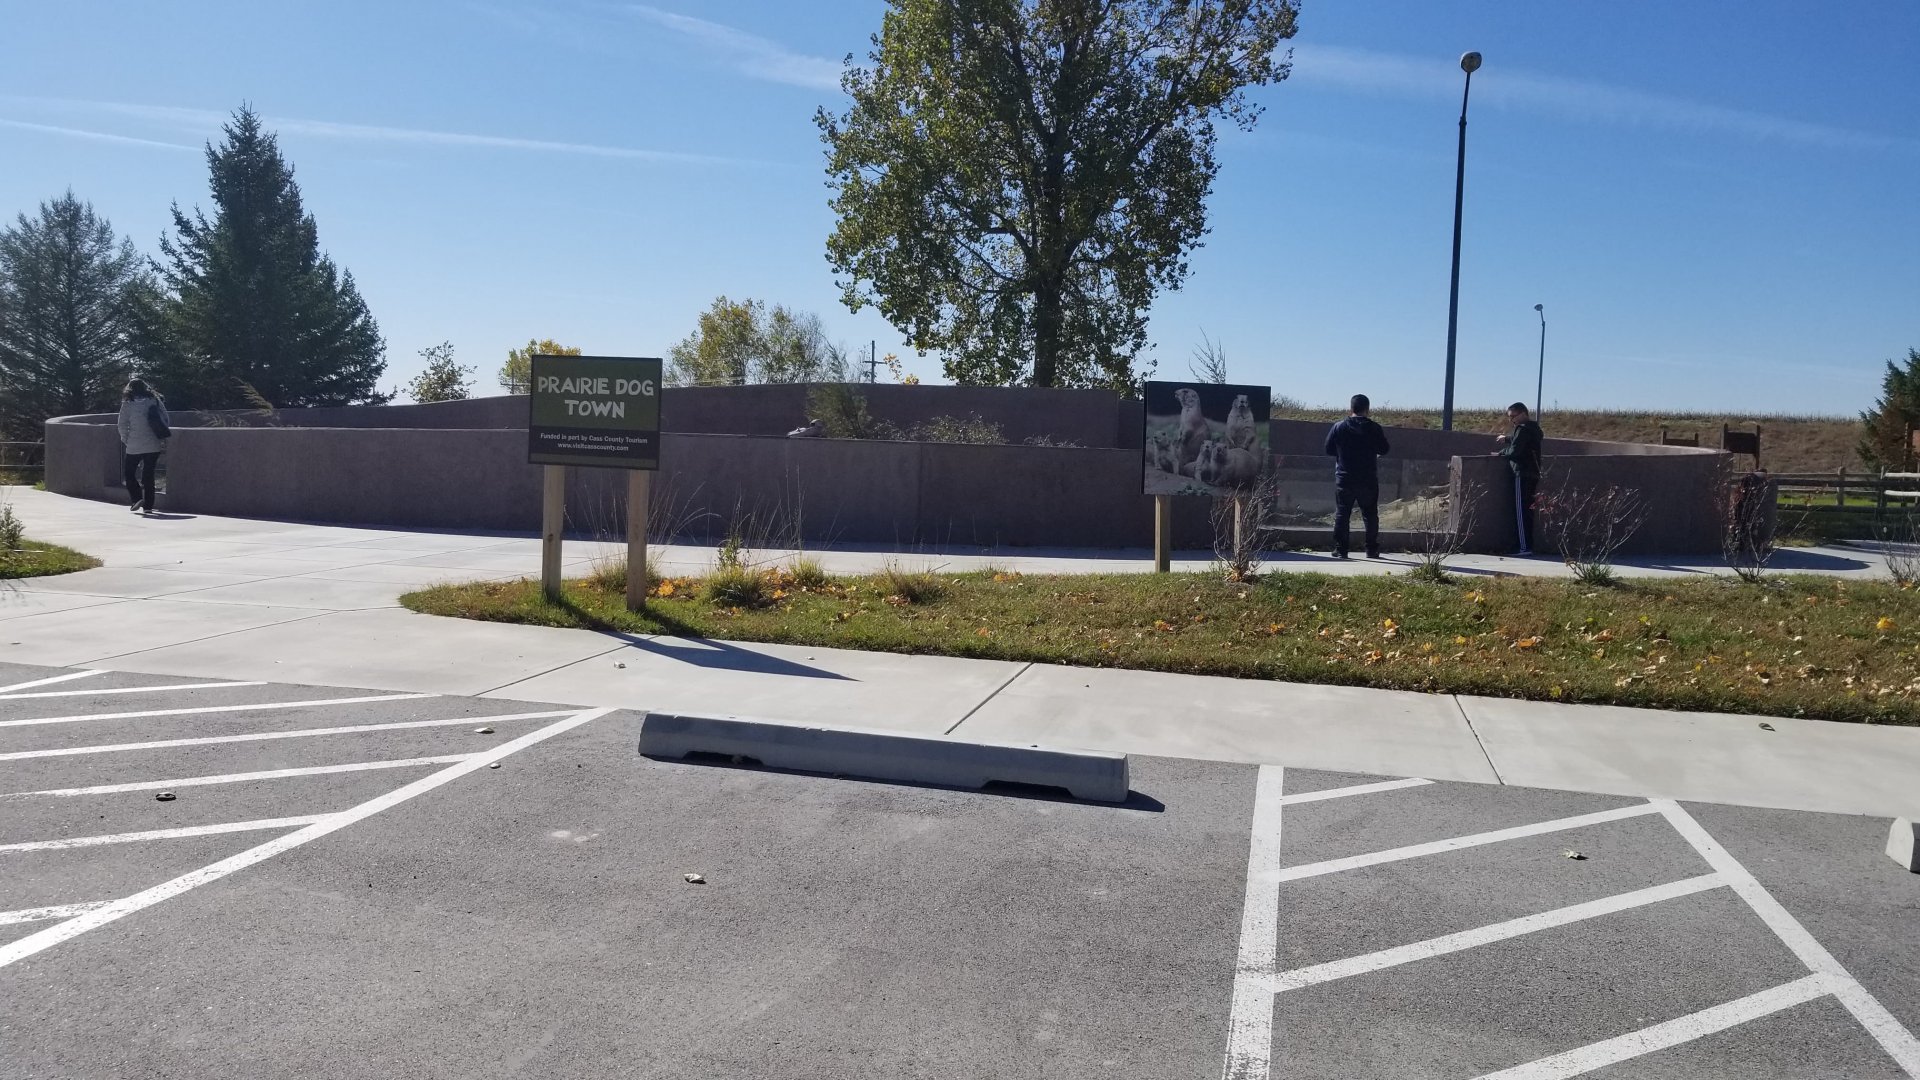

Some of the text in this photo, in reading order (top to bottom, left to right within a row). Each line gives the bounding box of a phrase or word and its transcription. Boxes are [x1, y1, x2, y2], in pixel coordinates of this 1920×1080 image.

[538, 376, 654, 396] PRAIRIE DOG
[564, 399, 625, 418] TOWN
[540, 432, 560, 440] Funded
[561, 433, 567, 441] in
[568, 434, 580, 442] part
[581, 434, 588, 442] by
[604, 435, 624, 444] County
[626, 436, 648, 444] Tourism
[557, 442, 629, 451] www.visitcasscounty.com
